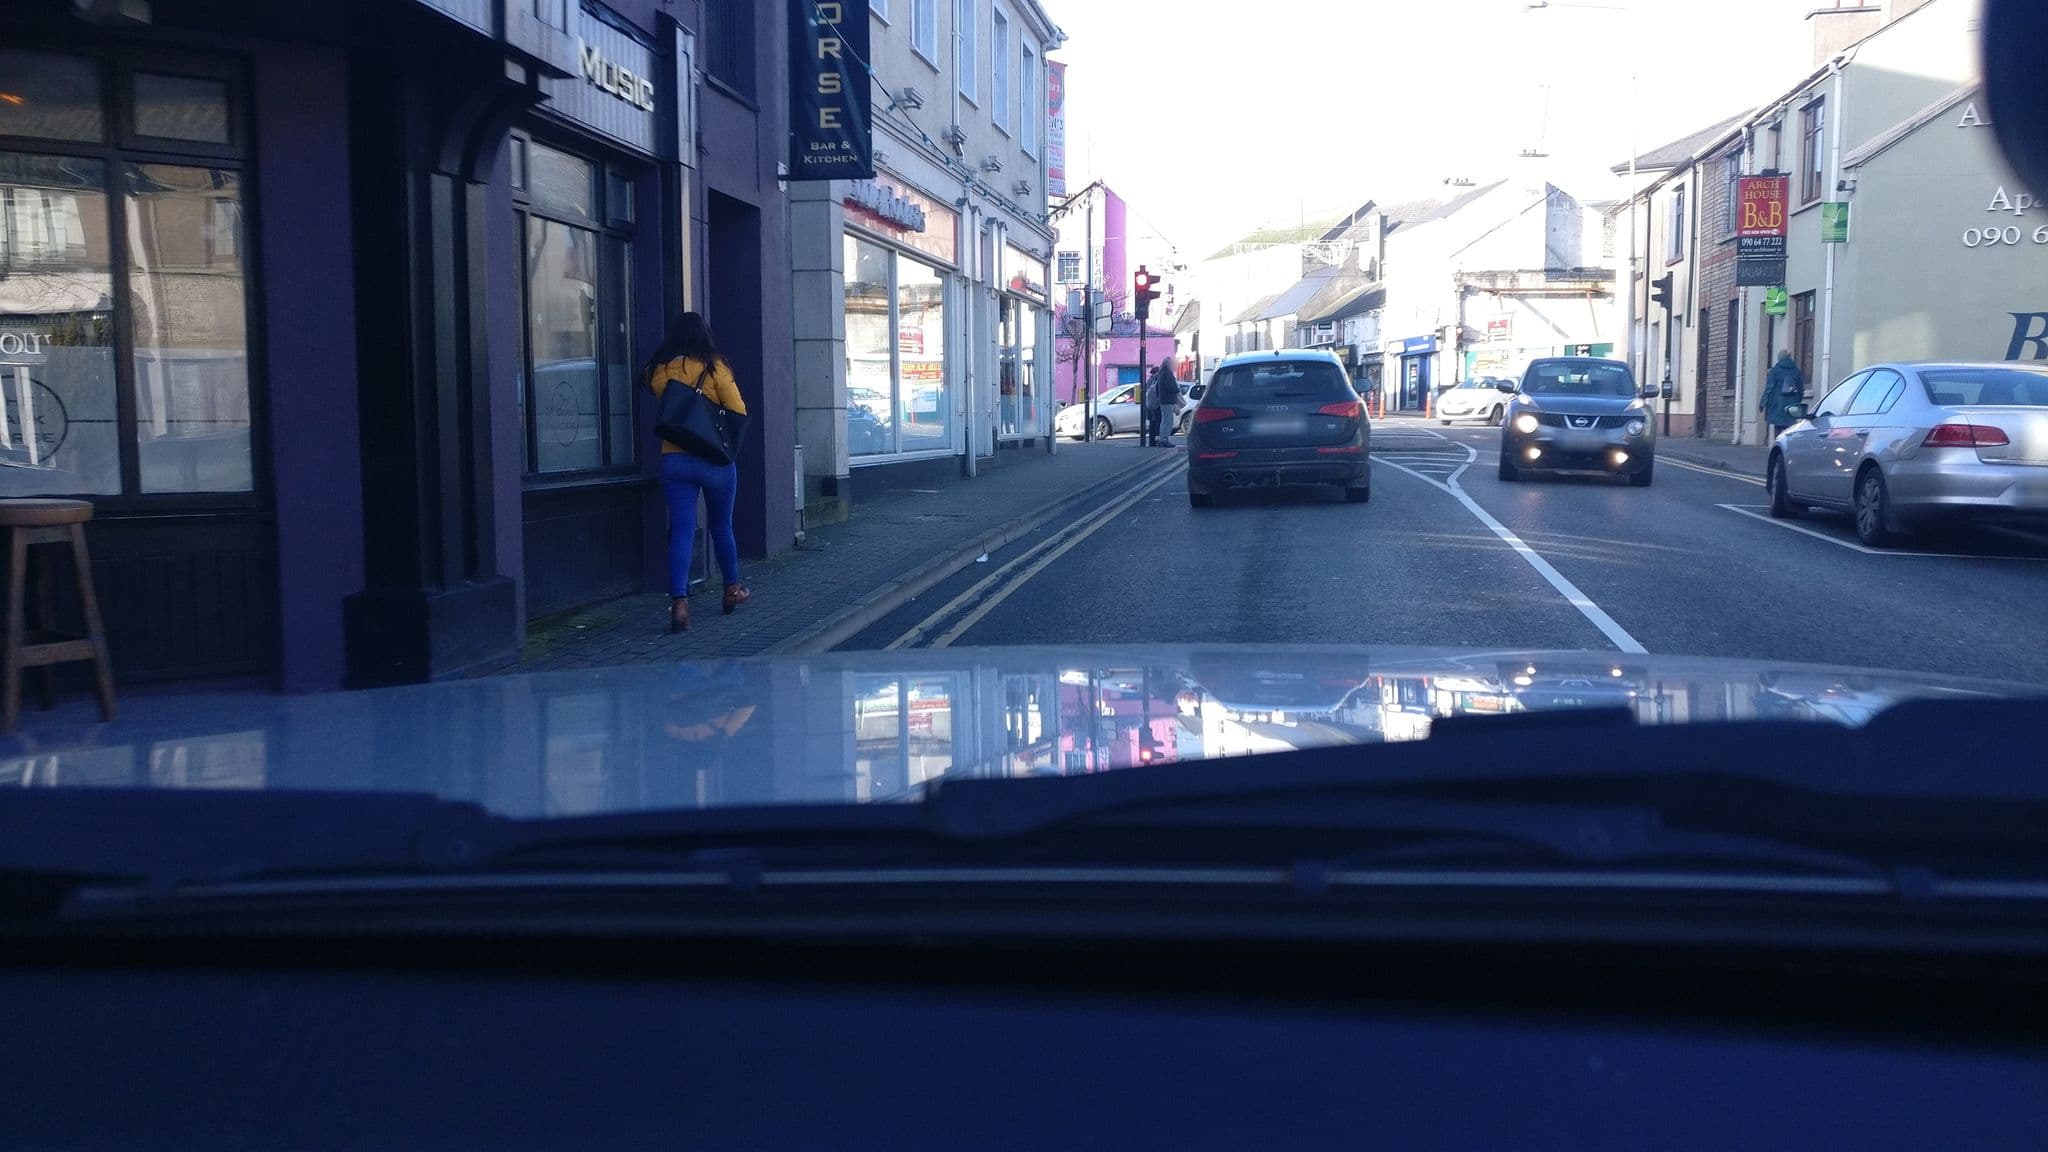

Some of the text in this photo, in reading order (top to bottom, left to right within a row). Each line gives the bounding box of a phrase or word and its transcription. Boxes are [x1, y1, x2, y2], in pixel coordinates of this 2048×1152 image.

[576, 34, 655, 112] MUSIC
[810, 140, 851, 151] BAR &
[804, 155, 858, 164] KITCHEN
[1747, 180, 1780, 190] ARCH
[1745, 190, 1782, 200] HOUSE
[1743, 201, 1783, 229] B&B
[1962, 225, 2021, 248] 090
[1741, 237, 1782, 247] 090 64 77 222
